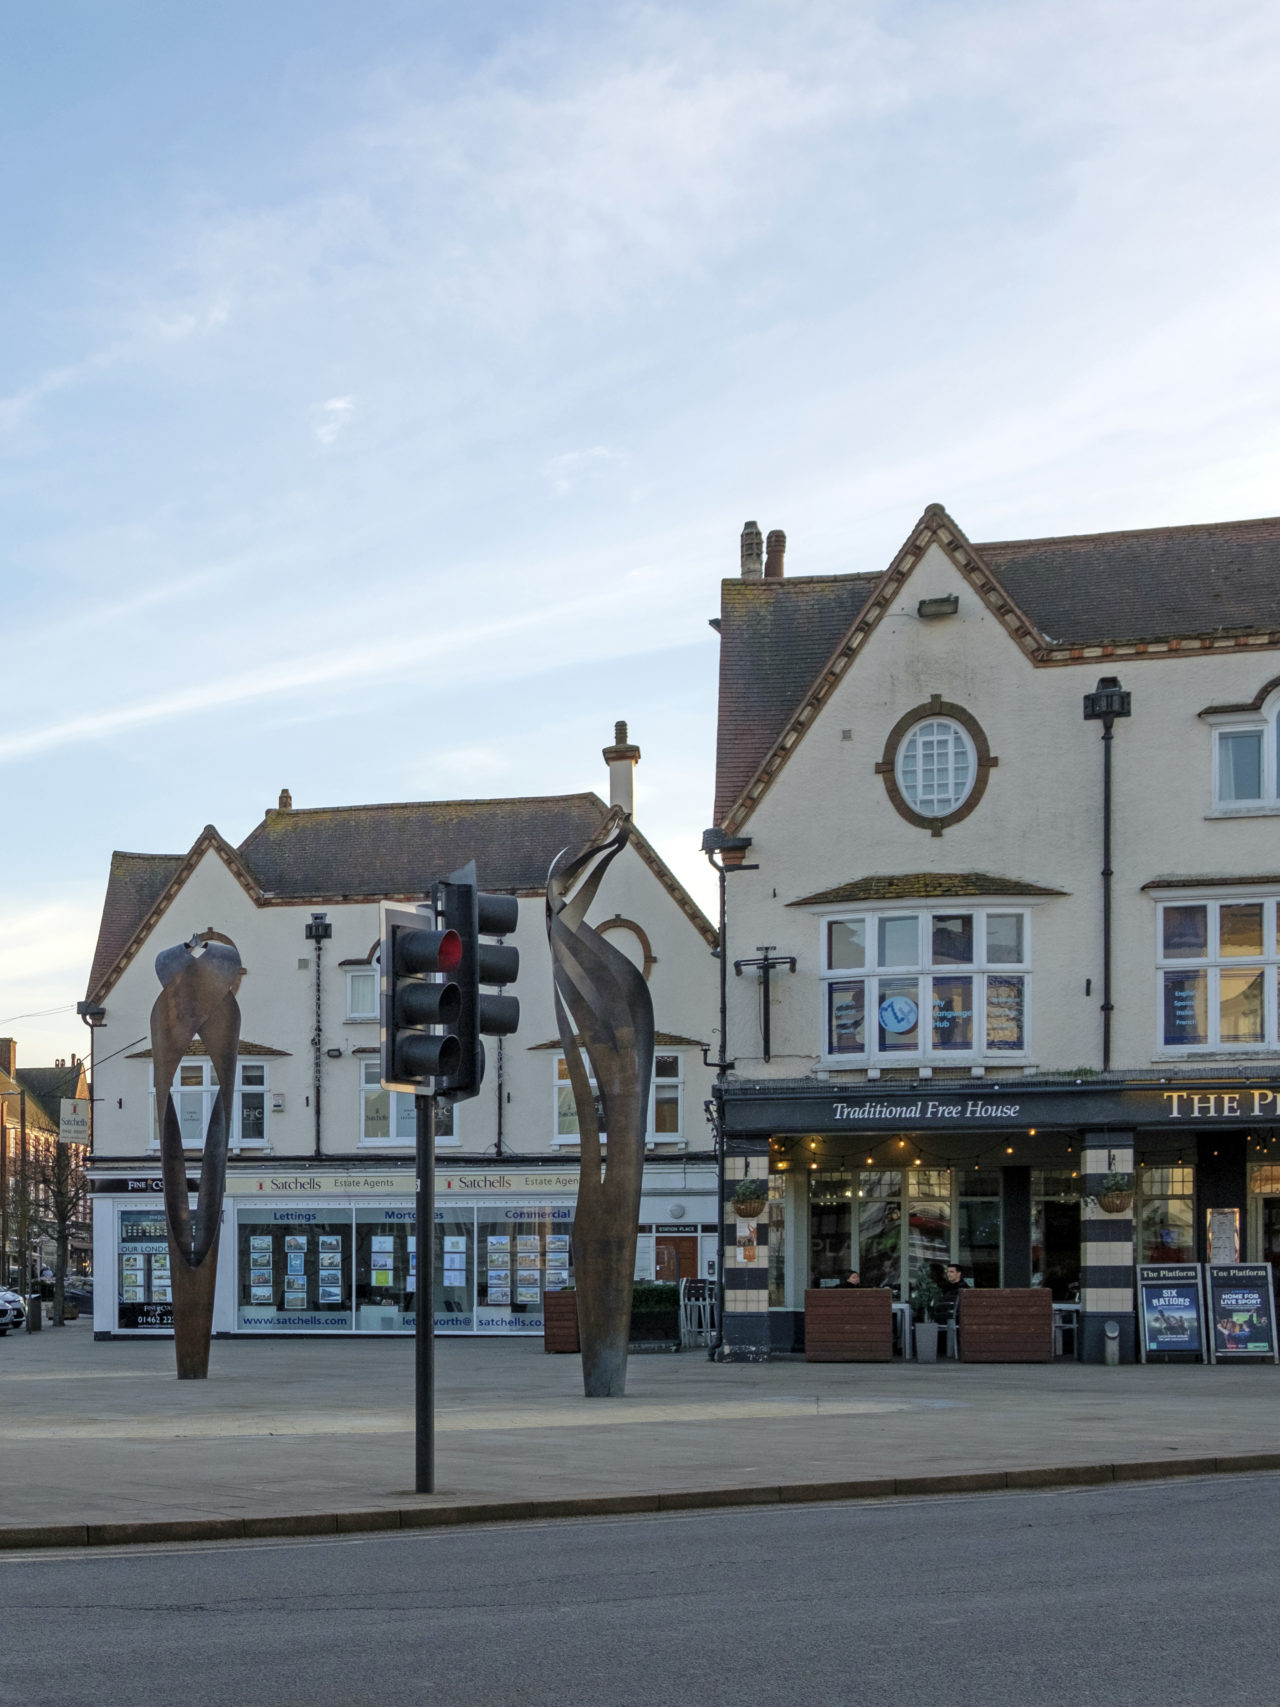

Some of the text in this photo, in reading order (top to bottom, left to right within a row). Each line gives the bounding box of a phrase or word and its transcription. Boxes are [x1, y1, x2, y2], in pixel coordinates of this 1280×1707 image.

[1163, 1092, 1241, 1118] THE
[833, 1101, 1020, 1119] Traditional Free House
[128, 1181, 146, 1190] FINE
[271, 1178, 394, 1190] Satchells Estate Agents
[459, 1176, 578, 1188] Satchells Estate Agen
[274, 1212, 316, 1221] Lettings
[385, 1211, 444, 1221] Mortges
[505, 1210, 570, 1219] Commercial
[1230, 1269, 1266, 1277] Platform
[1152, 1298, 1190, 1306] NATIONS
[243, 1316, 347, 1325] www.satchells.com
[479, 1317, 544, 1327] satchells.co.
